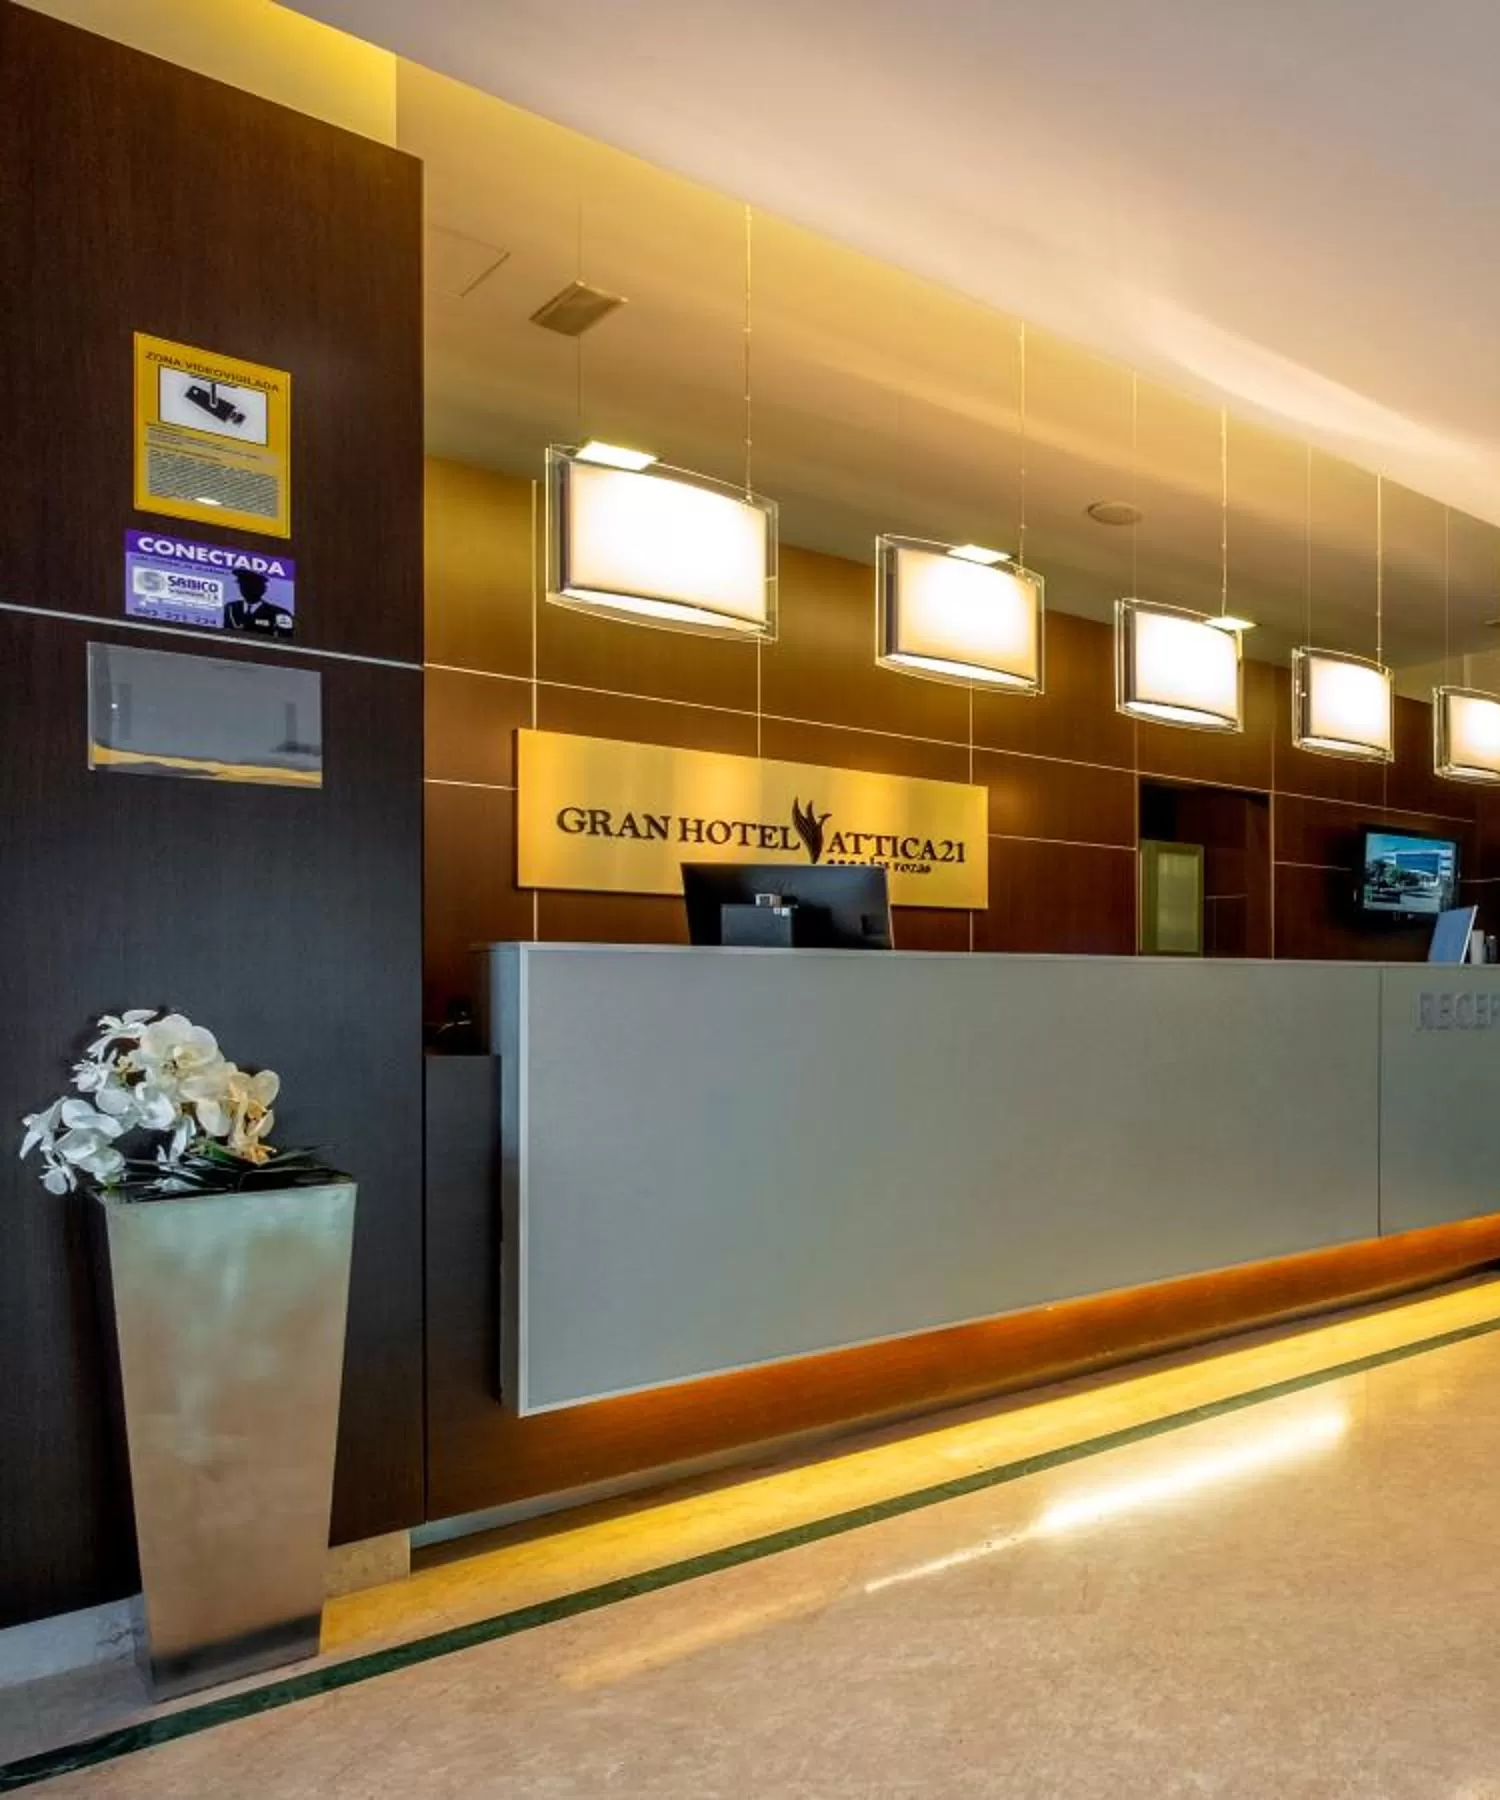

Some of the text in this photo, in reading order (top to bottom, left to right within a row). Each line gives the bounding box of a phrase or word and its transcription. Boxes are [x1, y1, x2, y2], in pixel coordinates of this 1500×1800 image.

[145, 351, 279, 392] ZONA VIDEOVIGILADA
[137, 537, 286, 577] CONECTADA
[556, 807, 967, 864] GRAN HOTEL ATTICA21
